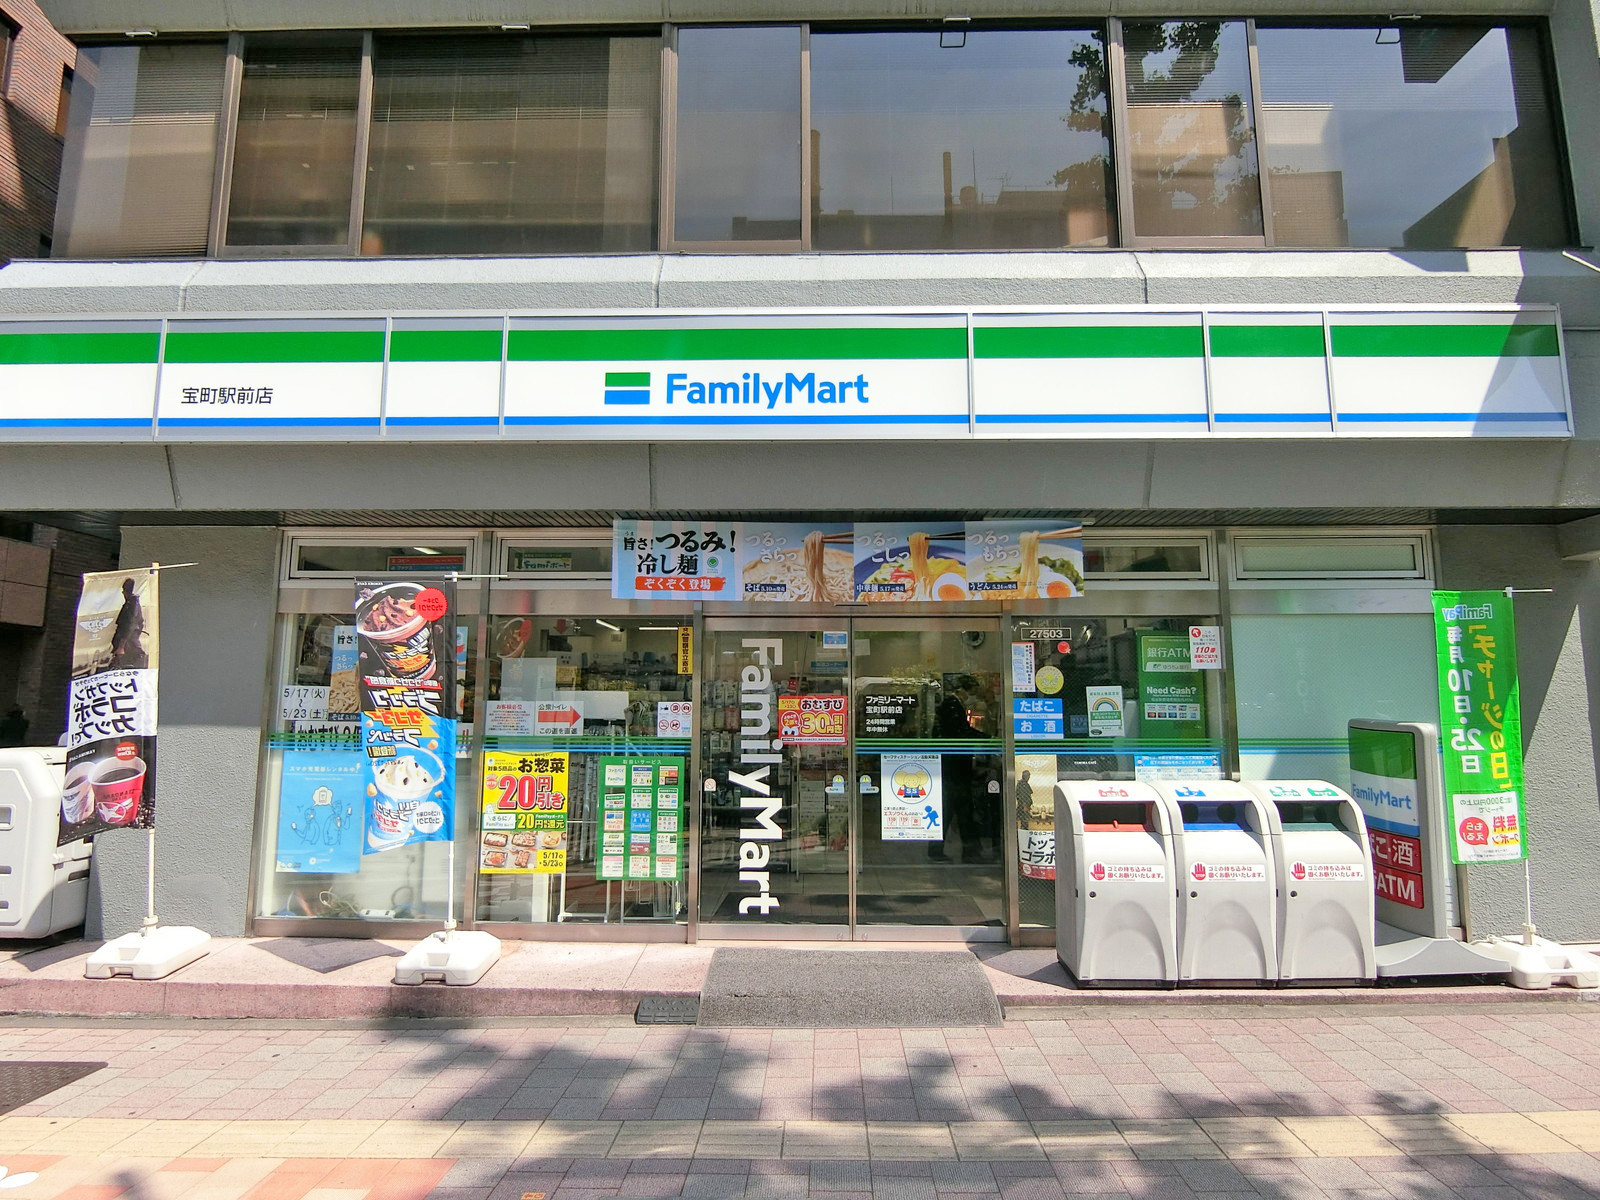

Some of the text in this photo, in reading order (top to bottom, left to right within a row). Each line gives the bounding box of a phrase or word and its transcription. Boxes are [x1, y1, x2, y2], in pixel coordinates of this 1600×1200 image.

[181, 387, 273, 404] 宝町駅前店
[667, 373, 869, 409] FamilyMart
[656, 530, 736, 552] つるみ!
[746, 531, 787, 548] つるっ
[857, 531, 898, 547] つるっ
[967, 531, 1009, 546] つるっ
[760, 548, 798, 564] さらっ
[871, 547, 911, 563] こしっ
[982, 545, 1019, 562] もちっ
[637, 553, 698, 575] 冷し麺
[644, 577, 711, 591] ぞくぞく登場
[745, 583, 760, 591] そば
[970, 583, 991, 591] うどん
[1030, 630, 1063, 638] 27503
[1147, 647, 1192, 658] 銀行ATM
[284, 688, 326, 699] 5/17(火)
[1147, 686, 1198, 695] Need Cash?
[801, 699, 844, 711] おむすび
[866, 696, 916, 705] ファミリーマート
[1020, 700, 1055, 711] たばこ
[282, 708, 325, 719] 5/23(土)
[866, 706, 903, 714] 宝町駅前店
[539, 727, 578, 735] この道を直進
[801, 713, 831, 736] 30
[518, 757, 566, 773] お惣菜
[728, 638, 783, 915] FamilyMart
[498, 774, 553, 811] 20 円
[1352, 783, 1412, 811] FamilyMart
[537, 793, 565, 811] 引き
[517, 813, 535, 829] 20
[1374, 869, 1416, 902] ATM
